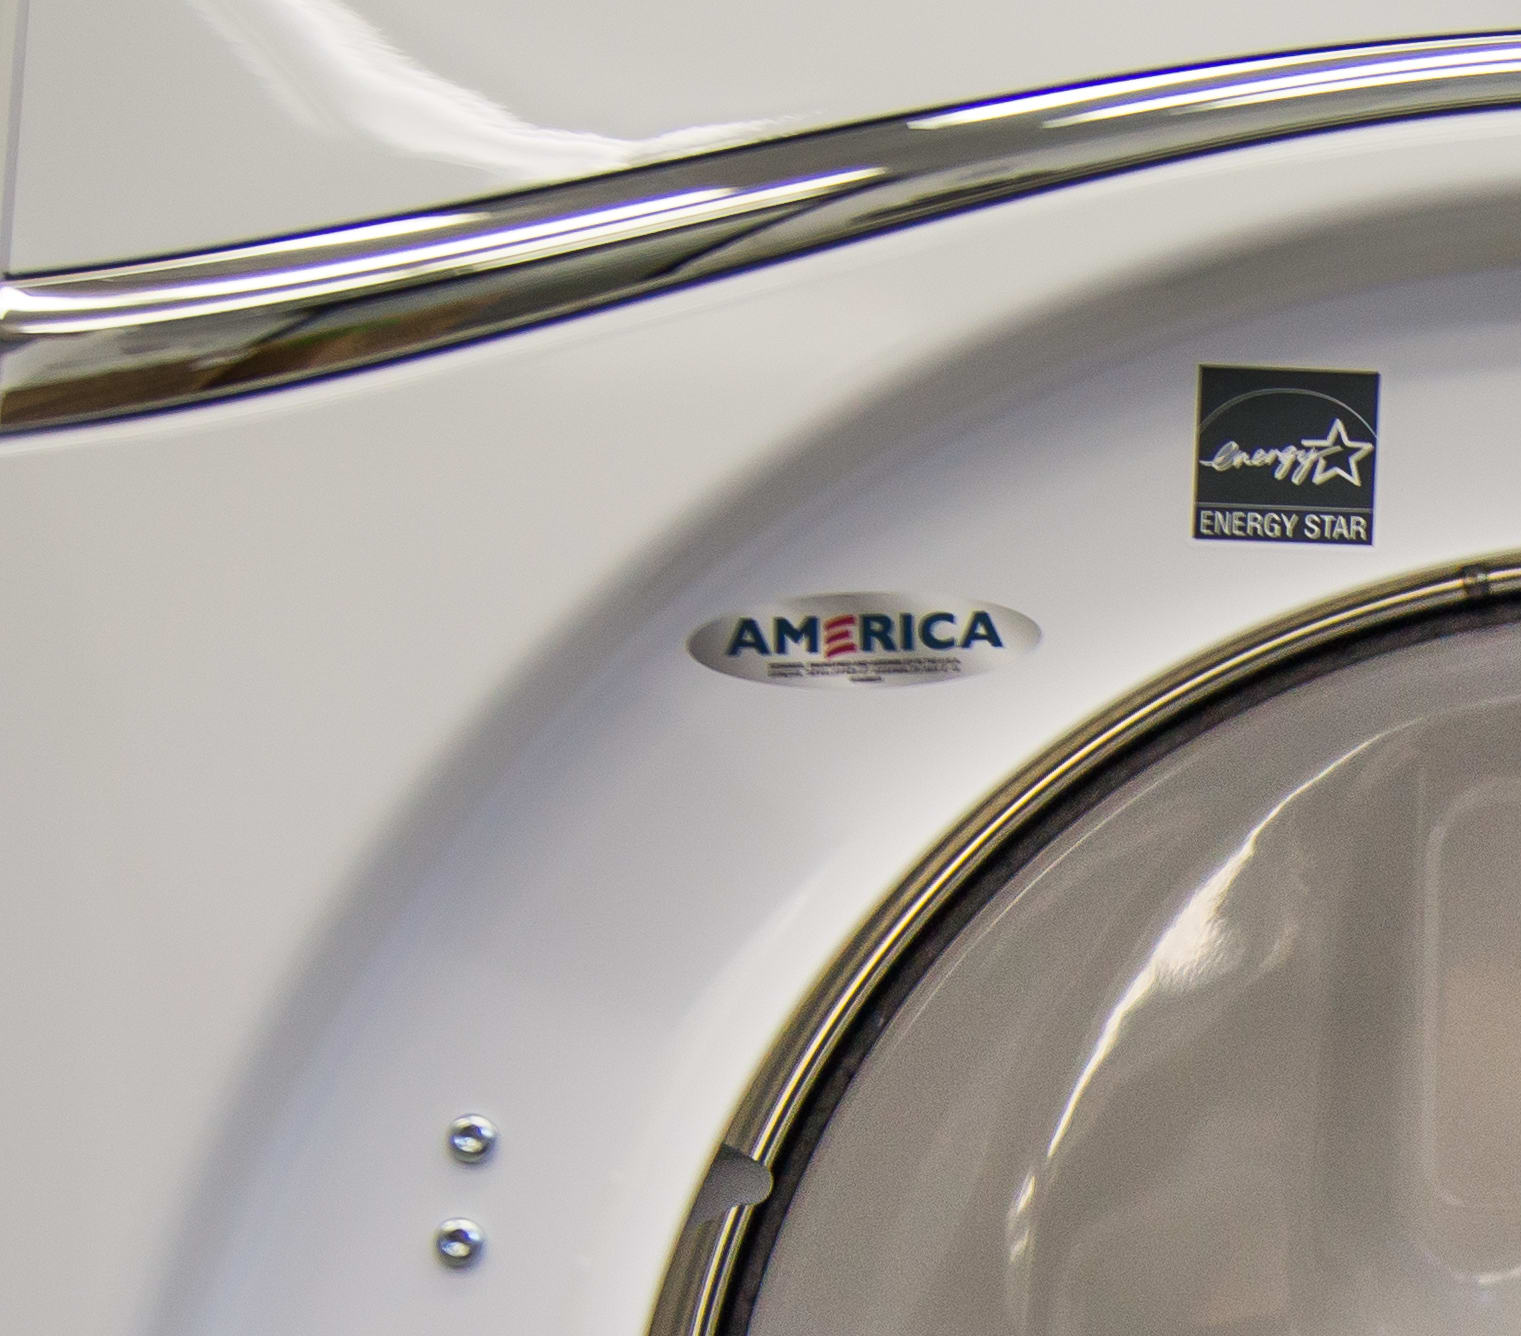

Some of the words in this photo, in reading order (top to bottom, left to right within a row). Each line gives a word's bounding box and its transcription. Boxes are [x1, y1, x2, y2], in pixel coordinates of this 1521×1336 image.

[1200, 510, 1299, 539] ENERGY
[1304, 513, 1368, 541] STAR
[726, 610, 1004, 659] AMERICA
